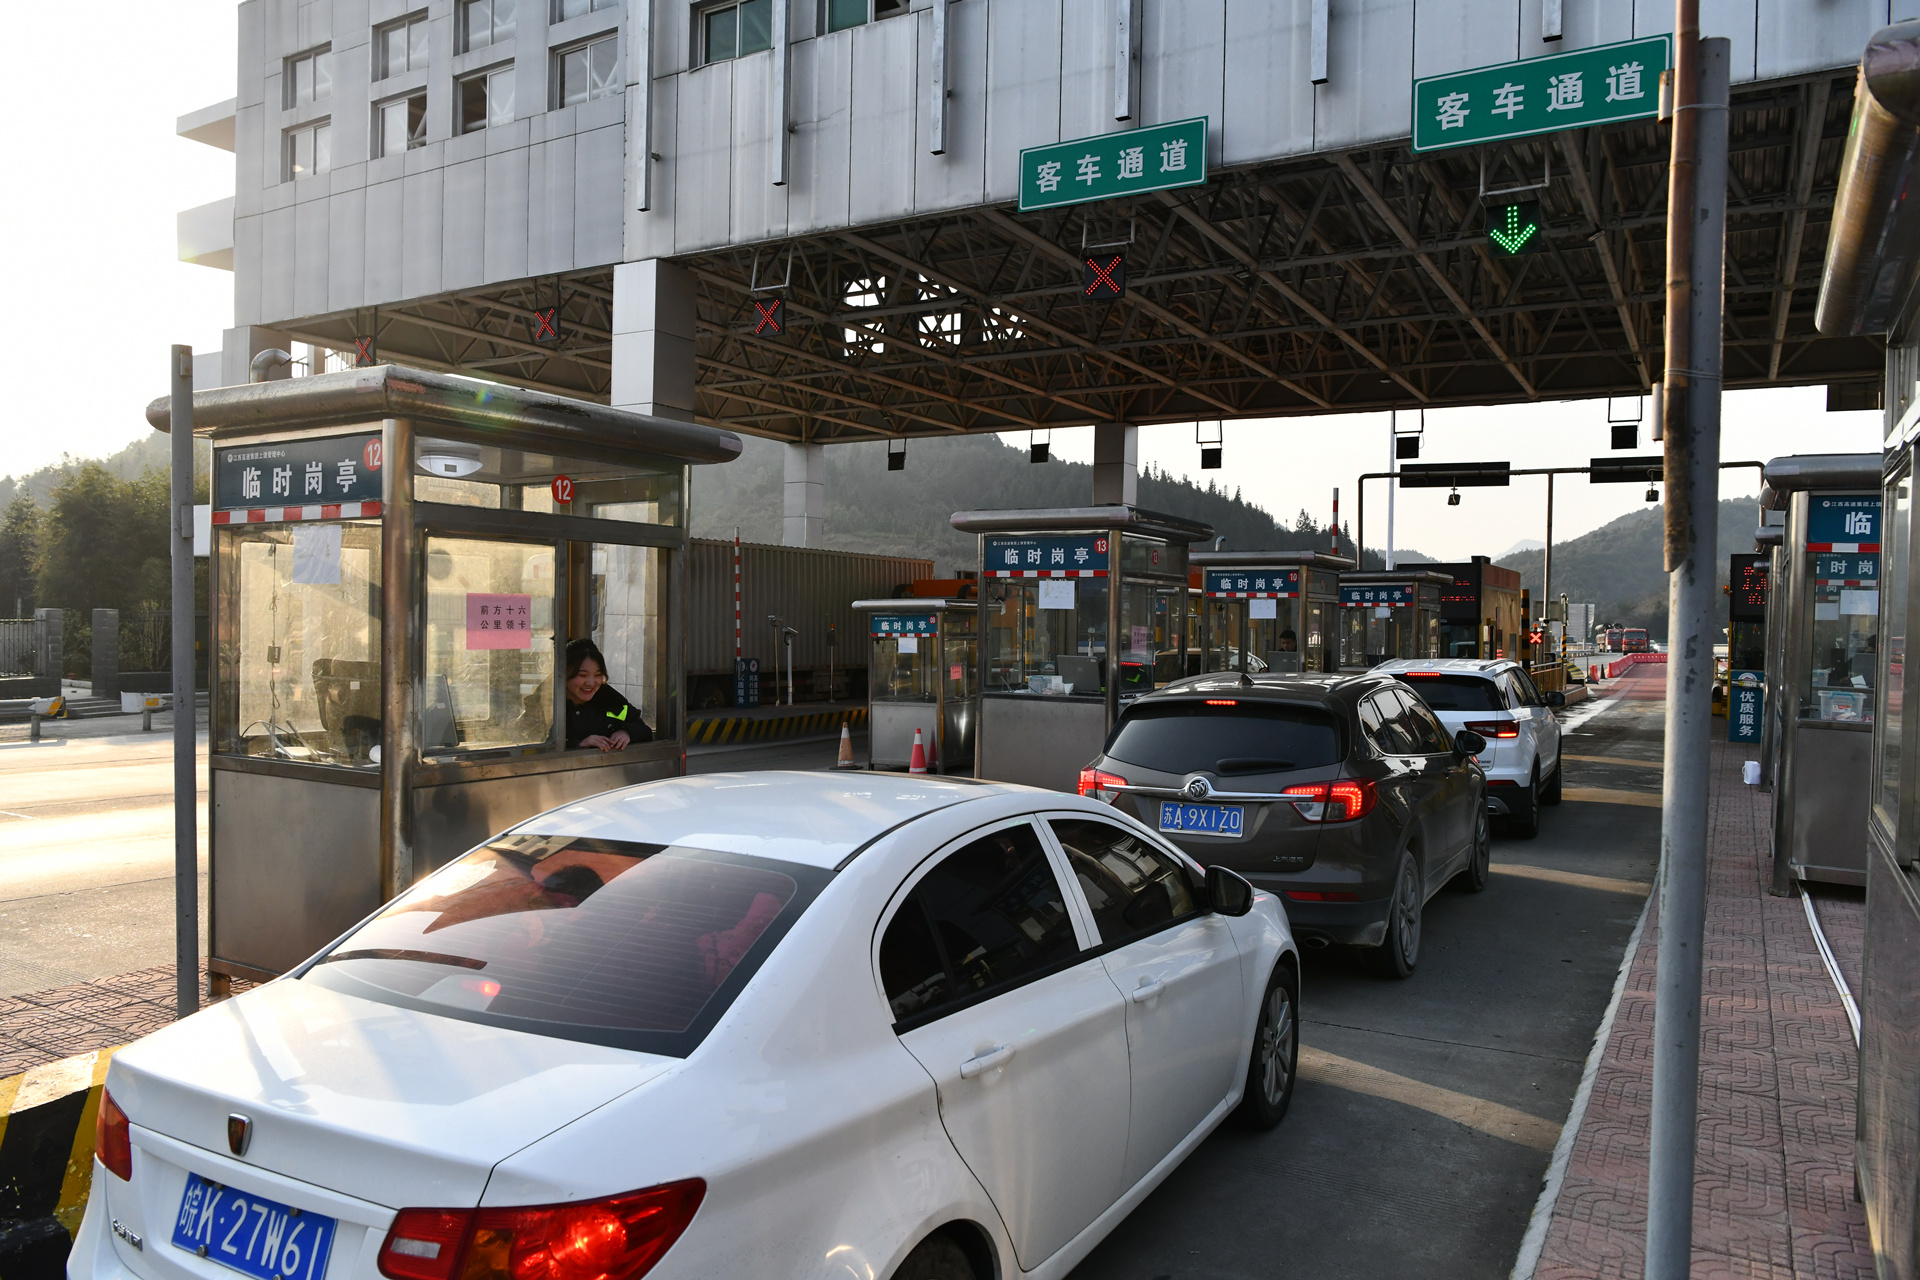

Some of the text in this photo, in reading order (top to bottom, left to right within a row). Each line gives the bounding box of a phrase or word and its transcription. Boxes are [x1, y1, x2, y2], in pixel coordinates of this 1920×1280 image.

[1435, 61, 1646, 130] 客车通道
[1036, 138, 1189, 193] 客车通道
[367, 442, 381, 467] 12
[242, 458, 357, 500] 临时岗亭
[555, 479, 572, 501] 12
[1096, 540, 1107, 552] 13
[1005, 547, 1089, 565] 临时岗亭
[1220, 577, 1284, 590] 临时岗亭
[1289, 572, 1298, 581] 10
[1351, 591, 1402, 600] 临时岗亭
[480, 605, 527, 616] 前方十六
[480, 619, 527, 630] 公里领卡
[881, 621, 927, 631] 临时岗亭
[1738, 691, 1756, 737] 优质服务
